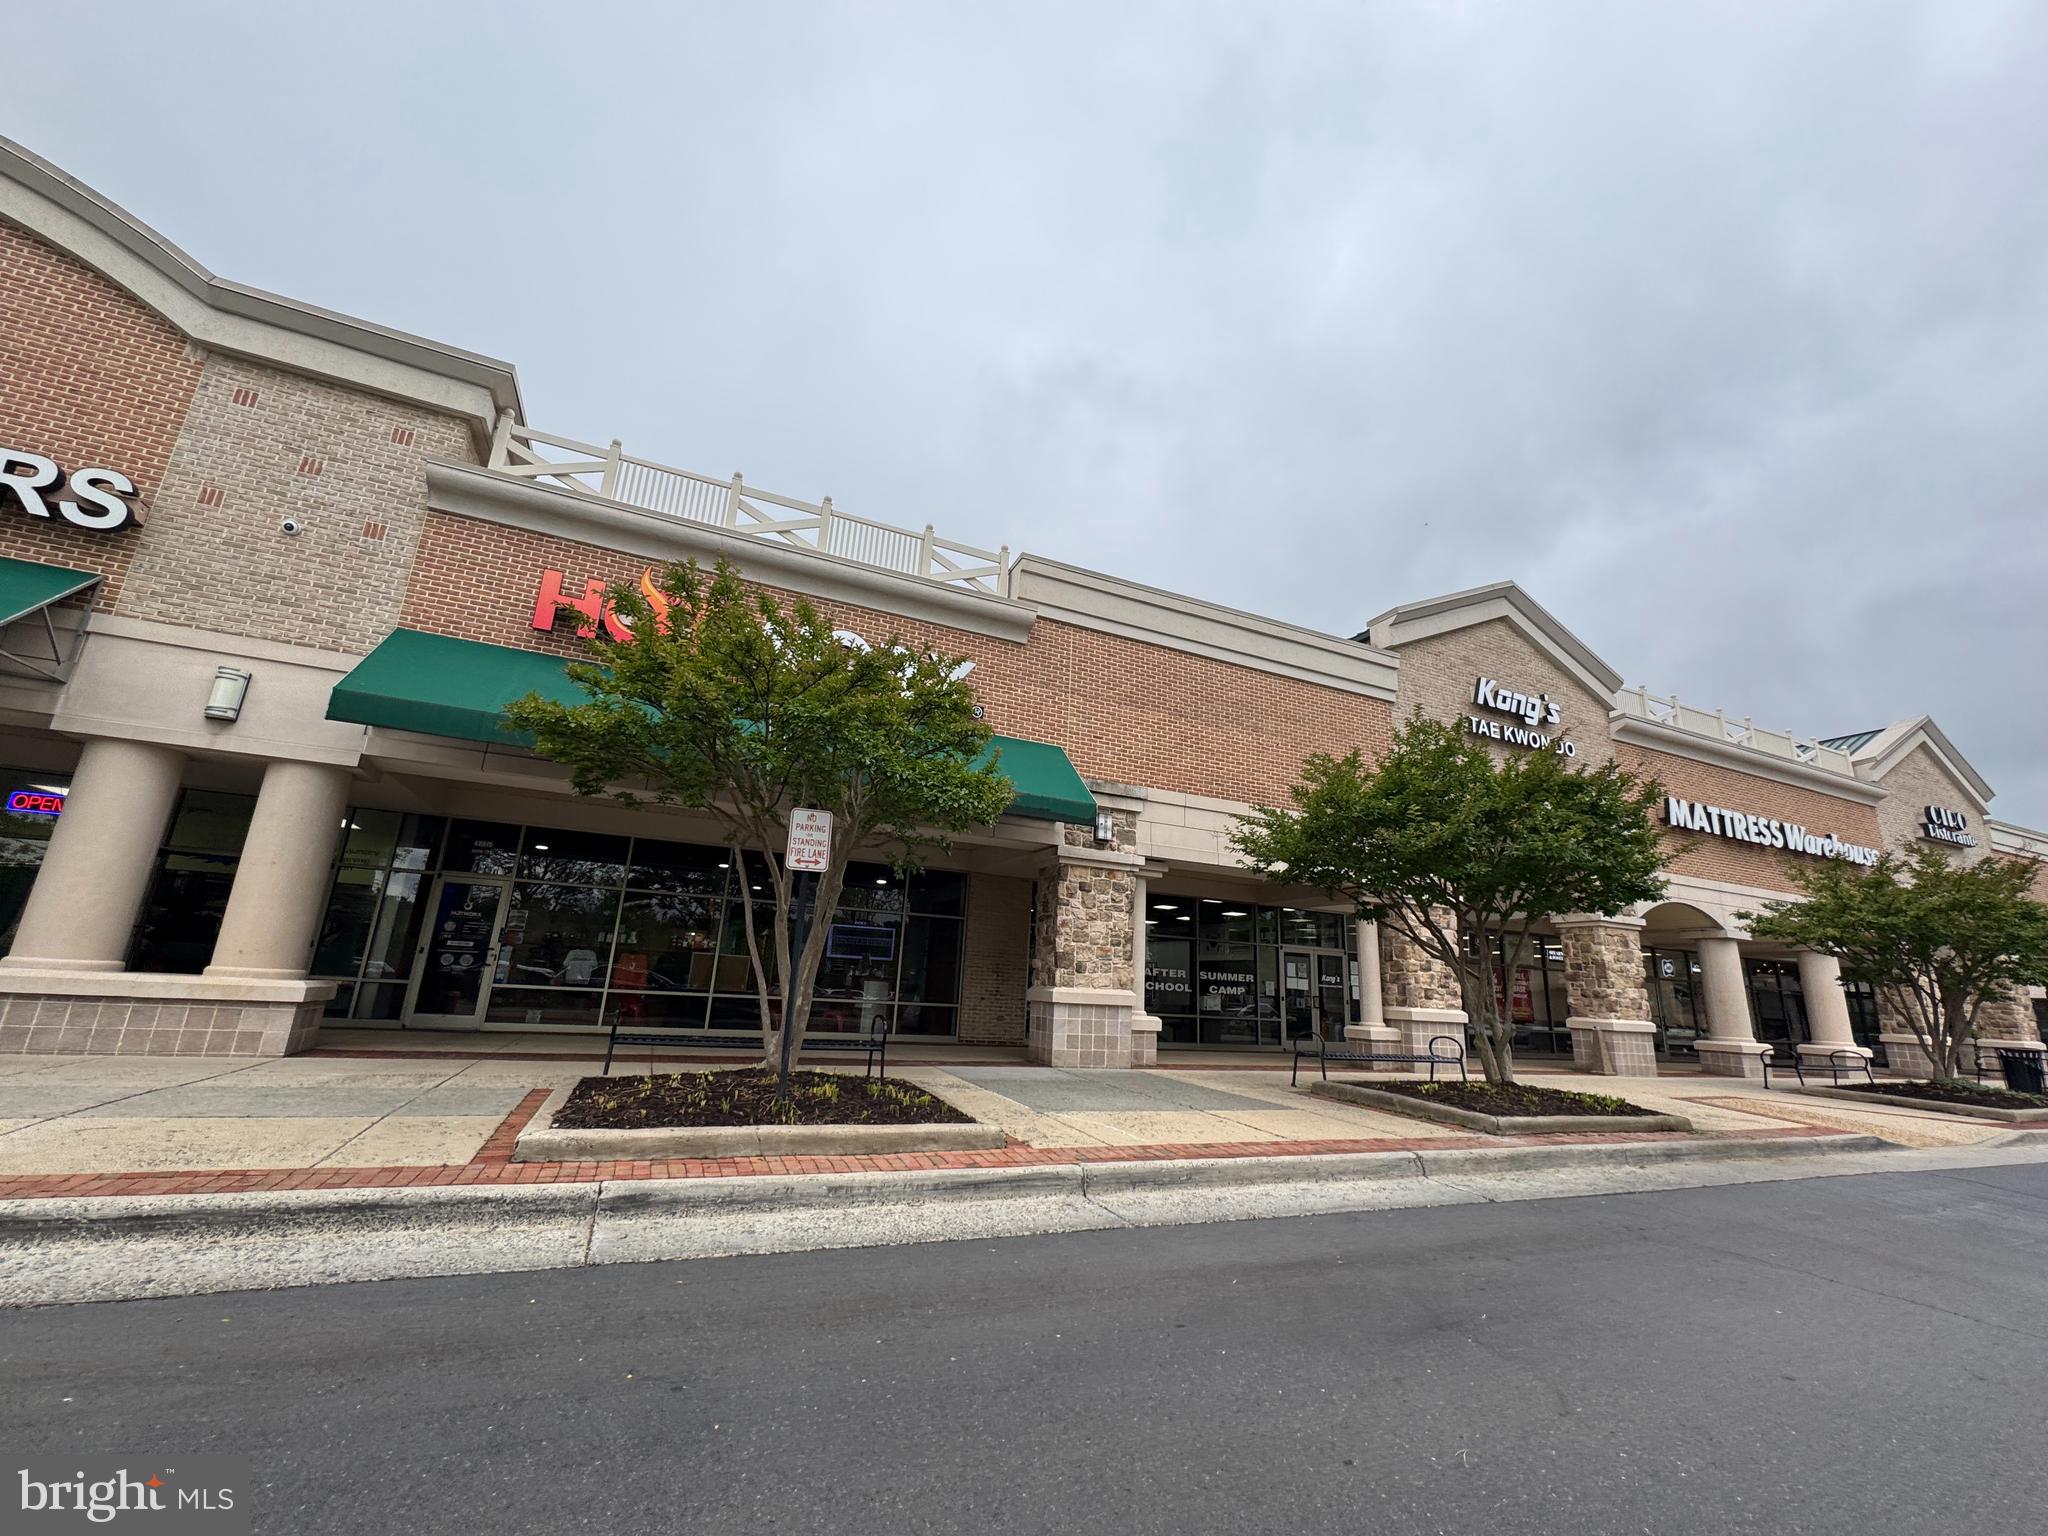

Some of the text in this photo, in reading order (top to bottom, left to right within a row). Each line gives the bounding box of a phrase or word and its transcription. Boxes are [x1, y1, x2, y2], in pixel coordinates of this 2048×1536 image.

[0, 447, 134, 530] RS
[1477, 676, 1561, 726] Kang's
[1469, 716, 1501, 739] TAE
[12, 794, 63, 812] OPEN
[807, 814, 817, 823] NO
[795, 823, 827, 833] PARKING
[1668, 796, 1880, 867] MATTRESS Warehouse
[792, 838, 827, 848] STANDING
[790, 847, 827, 859] FIRE LANE
[1145, 967, 1187, 978] AFTER
[1199, 971, 1255, 983] SUMMER
[1145, 981, 1193, 992] CHOOL
[1208, 985, 1246, 995] CAMP
